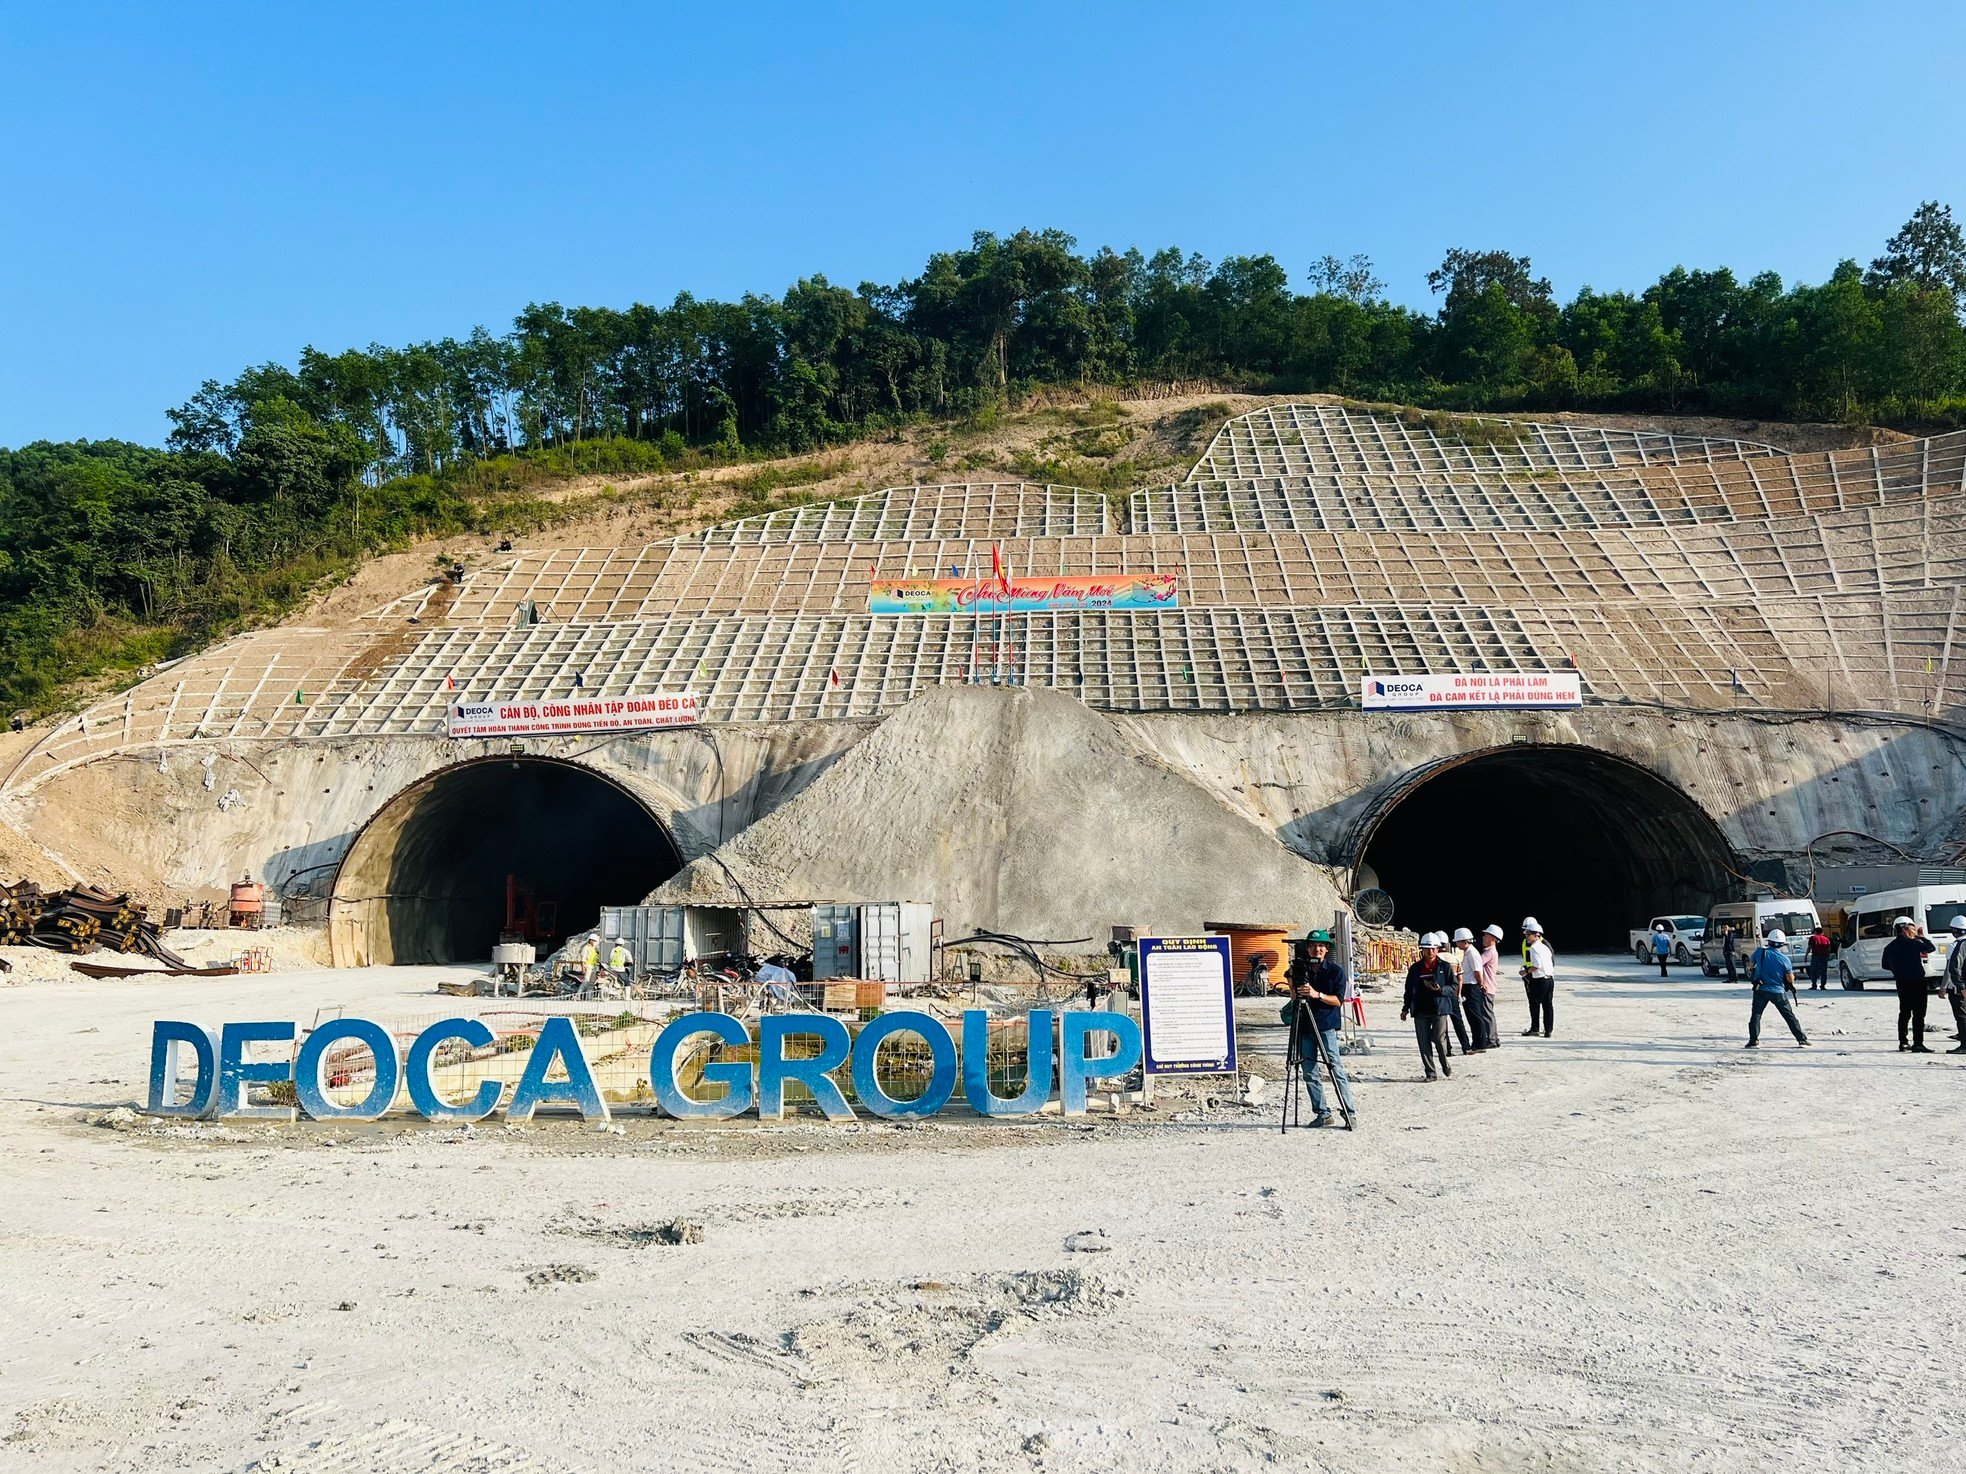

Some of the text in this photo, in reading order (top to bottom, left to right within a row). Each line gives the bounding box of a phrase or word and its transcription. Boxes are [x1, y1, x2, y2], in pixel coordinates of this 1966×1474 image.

[1387, 684, 1423, 692] DEOCA
[1445, 692, 1467, 701] CAM
[466, 707, 493, 715] DEOCA
[543, 703, 571, 718] CÔNG
[573, 702, 602, 716] NHÂN
[605, 700, 624, 716] TẬP
[627, 698, 655, 713] ĐOÀN
[658, 696, 679, 711] ĐÈO
[623, 719, 633, 727] AN
[147, 1009, 1142, 1122] DEOCA GROUP
